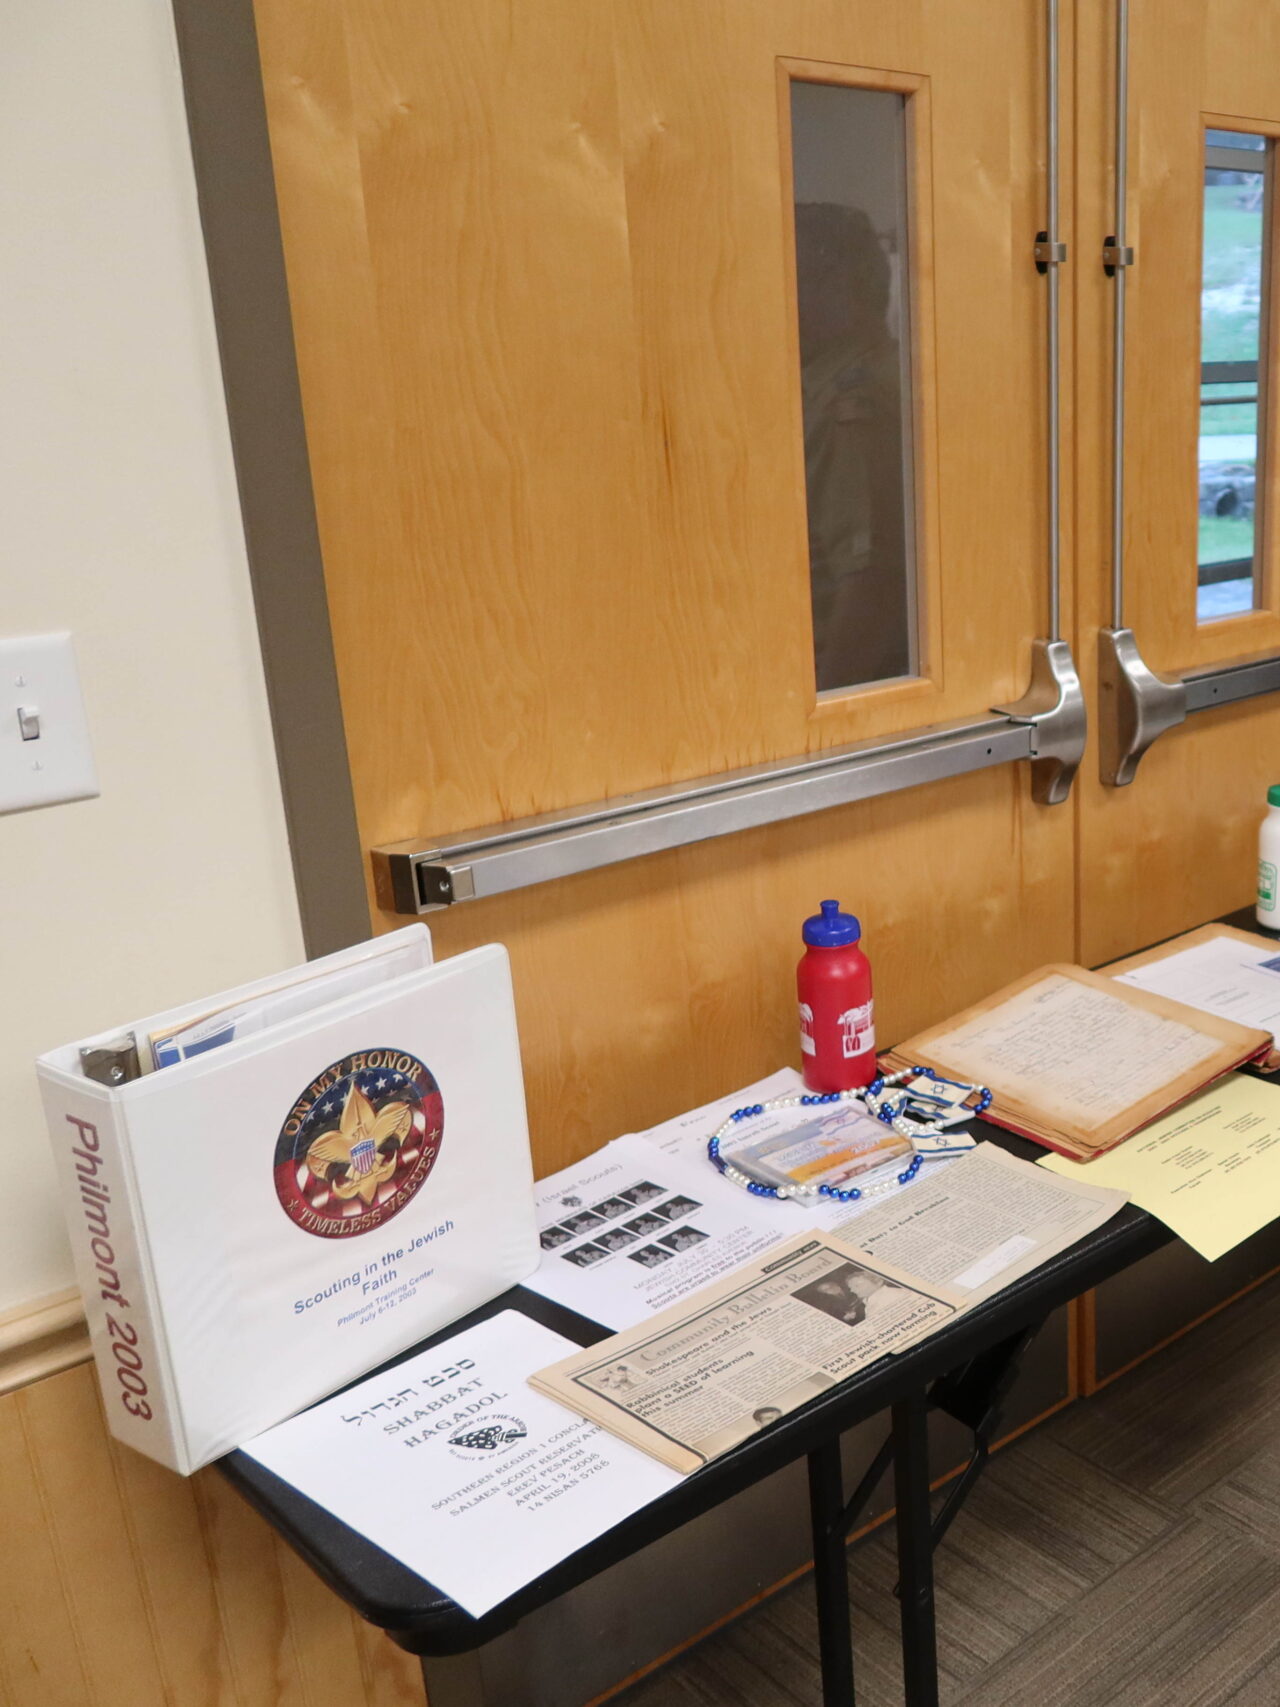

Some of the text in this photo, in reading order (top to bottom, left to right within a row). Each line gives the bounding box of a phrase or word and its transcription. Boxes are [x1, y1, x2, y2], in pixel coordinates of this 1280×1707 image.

[284, 1051, 423, 1137] ON MY HONOR
[301, 1146, 436, 1235] TIMELESS VALUES
[65, 1113, 153, 1421] Philmont 2003
[293, 1219, 455, 1315] Scouting in the Jewish
[362, 1268, 398, 1296] Faith
[674, 1270, 704, 1292] program
[337, 1268, 435, 1327] Philmont Training Center
[359, 1310, 376, 1326] July
[639, 1312, 731, 1363] Community
[733, 1277, 788, 1316] Bulletin
[784, 1256, 833, 1287] Board
[651, 1294, 677, 1310] Scouts
[645, 1306, 773, 1377] Shakespeare and the Jews
[822, 1302, 936, 1371] First Jewish-chartered Cub
[830, 1310, 938, 1374] Scout pack now forming
[383, 1377, 484, 1435] SHABBAT
[626, 1358, 724, 1410] Rabbinical students
[635, 1397, 664, 1416] plant
[672, 1379, 699, 1396] SEED
[700, 1371, 712, 1382] of
[712, 1350, 755, 1376] learning
[641, 1385, 705, 1419] this summer
[403, 1391, 509, 1449] HAGADOL
[431, 1472, 495, 1511] SOUTHERN
[495, 1447, 539, 1475] REGION
[548, 1417, 593, 1444] CONCLA
[449, 1486, 501, 1517] SALMEN
[501, 1463, 537, 1488] SCOUT
[538, 1425, 602, 1468] RESERVATI
[507, 1476, 539, 1498] EREV
[540, 1448, 585, 1478] PESACH
[514, 1483, 552, 1507] APRIL
[572, 1452, 601, 1472] 2008
[527, 1500, 544, 1513] 14
[543, 1478, 580, 1503] NISAN
